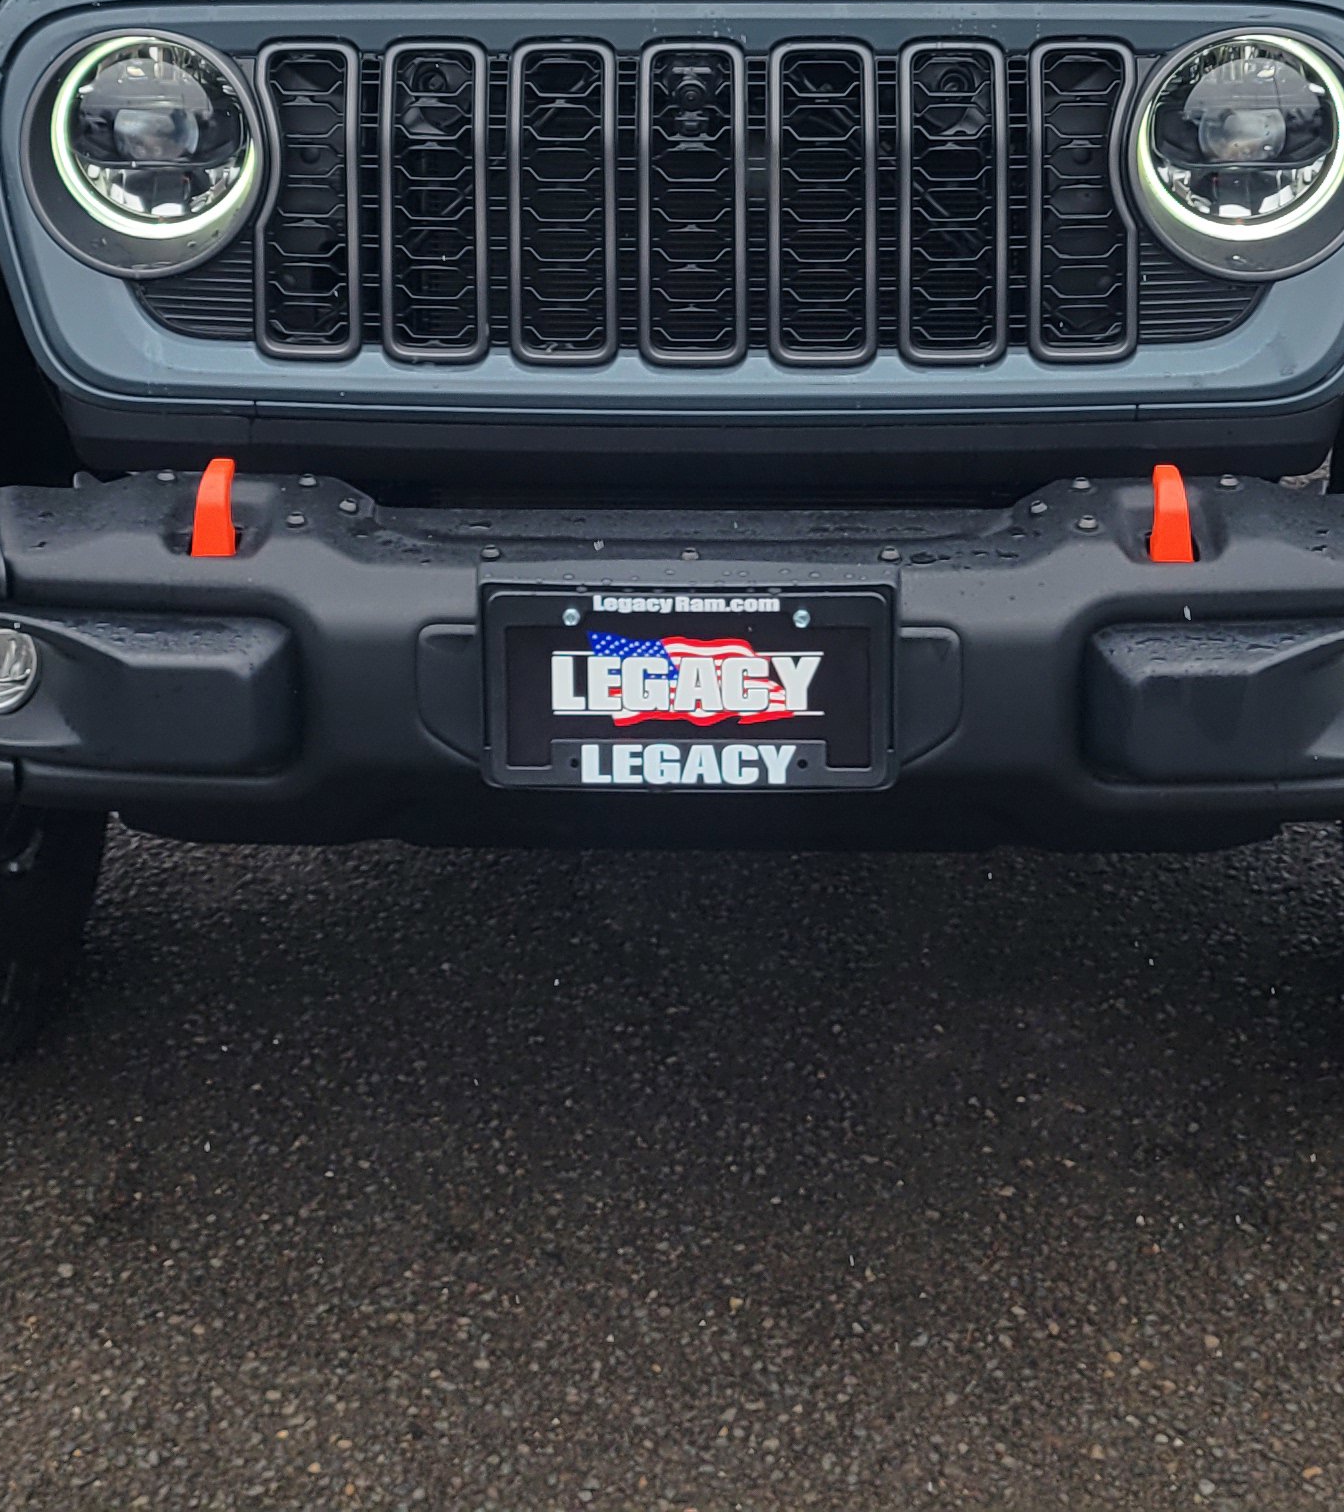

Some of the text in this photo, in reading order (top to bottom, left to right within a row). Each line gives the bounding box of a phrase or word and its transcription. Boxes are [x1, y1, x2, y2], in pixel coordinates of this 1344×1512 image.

[593, 595, 673, 614] Legacy
[551, 655, 821, 712] LEGACY
[580, 744, 796, 784] LEGACY
